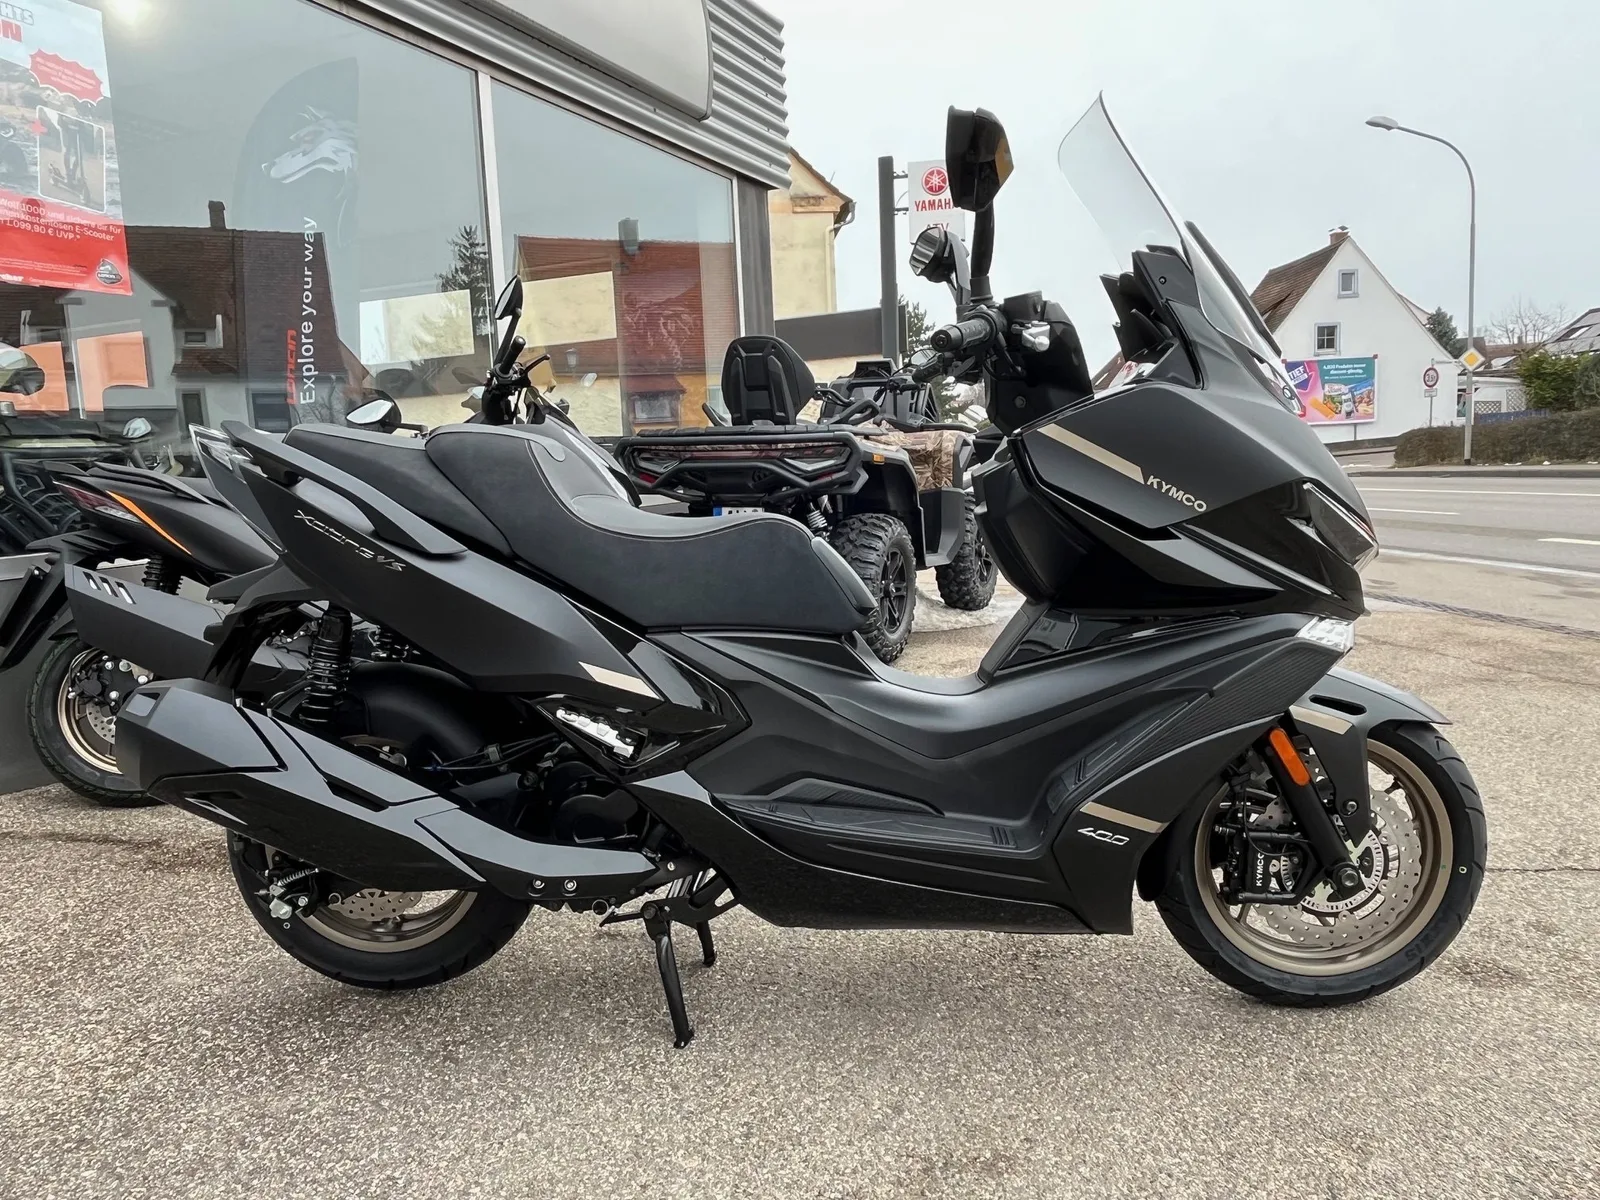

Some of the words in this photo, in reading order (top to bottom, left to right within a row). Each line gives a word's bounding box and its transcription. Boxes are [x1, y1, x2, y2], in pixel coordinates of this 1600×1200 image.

[20, 203, 46, 216] 1000
[914, 198, 954, 212] YAMAH
[75, 225, 115, 241] E-Scooter
[304, 216, 317, 262] way
[303, 267, 316, 316] your
[297, 321, 318, 404] Explore
[1288, 365, 1304, 380] TIEF
[1146, 475, 1208, 513] KYMCO
[1077, 827, 1130, 846] 400
